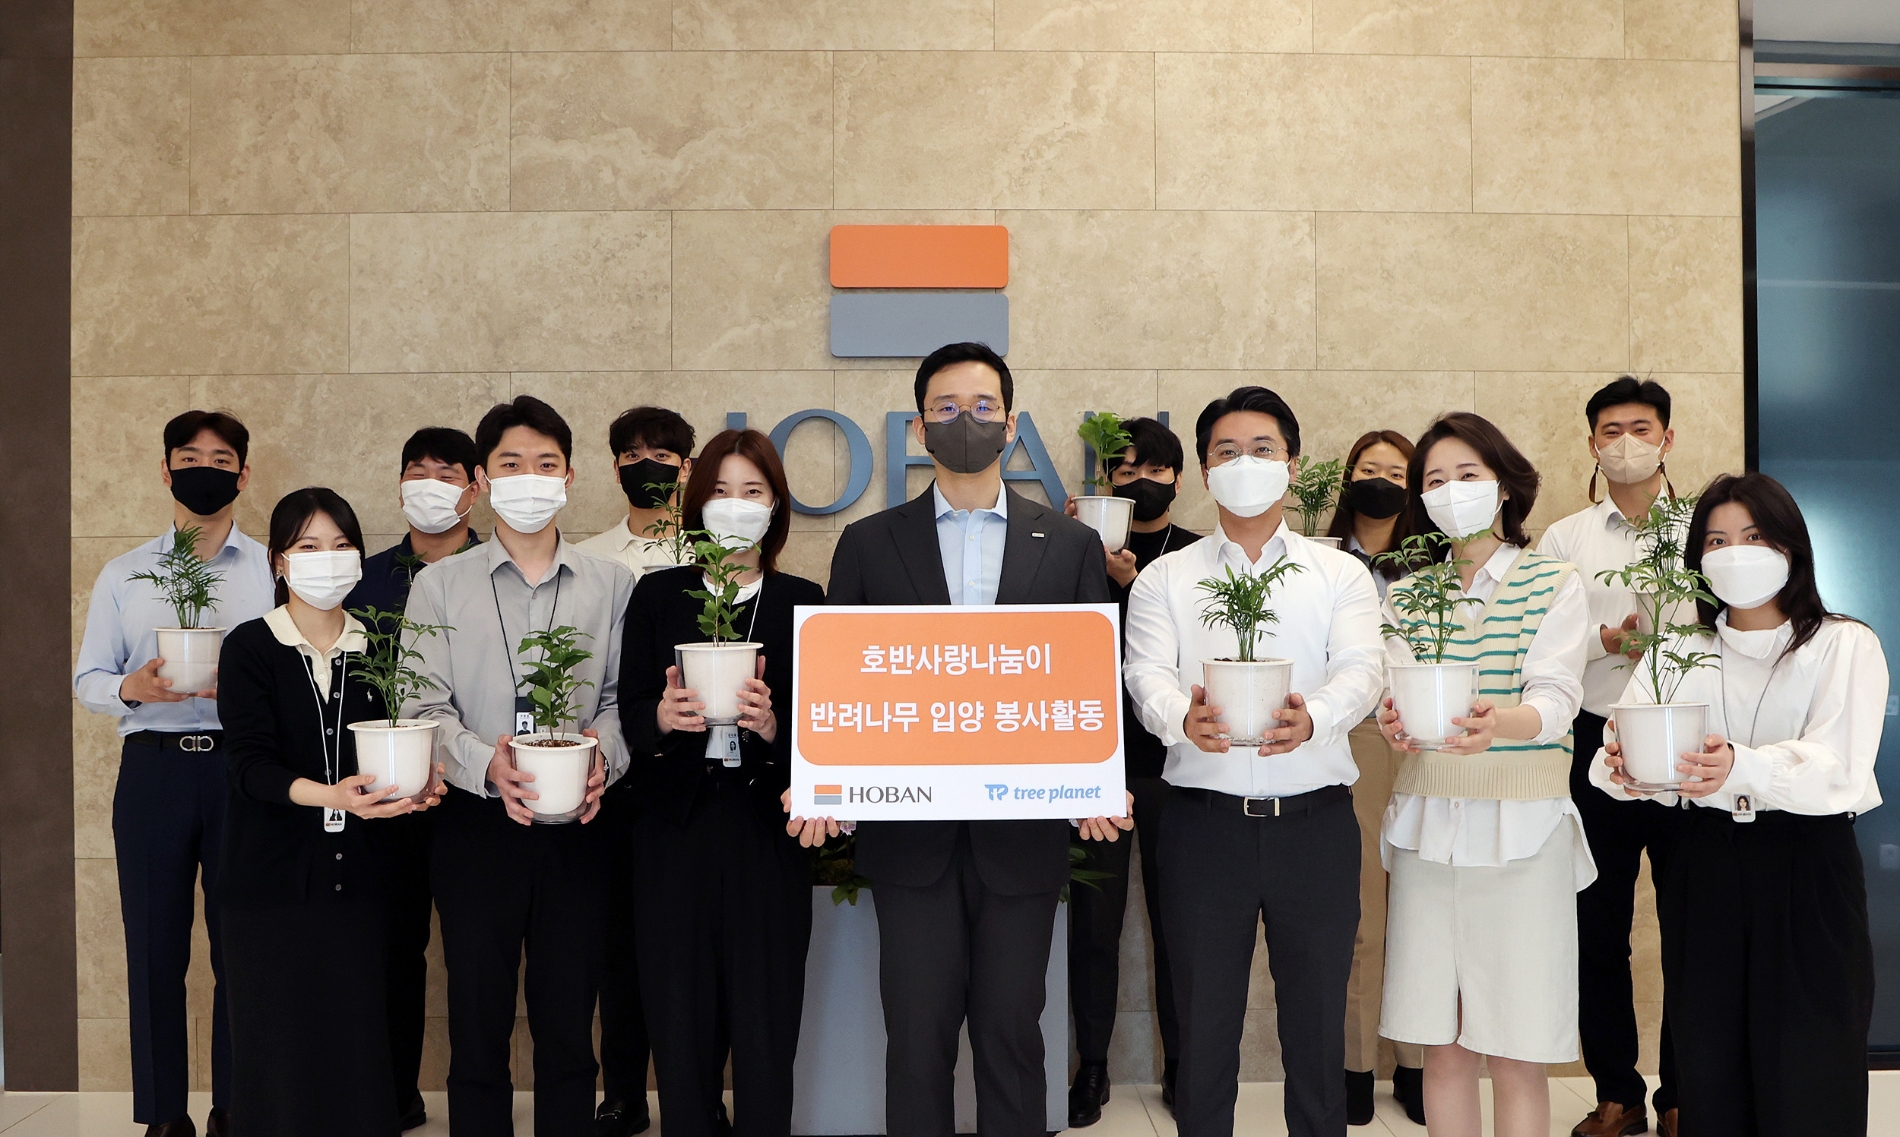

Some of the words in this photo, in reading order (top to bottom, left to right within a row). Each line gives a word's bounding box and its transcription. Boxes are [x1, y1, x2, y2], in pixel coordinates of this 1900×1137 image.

[860, 643, 1051, 676] 호반사랑나눔이
[810, 701, 920, 733] 반려나무
[930, 701, 985, 733] 입양
[993, 699, 1105, 733] 봉사활동
[849, 786, 932, 804] HOBAN
[1013, 786, 1046, 800] tree
[1048, 784, 1102, 804] planet
